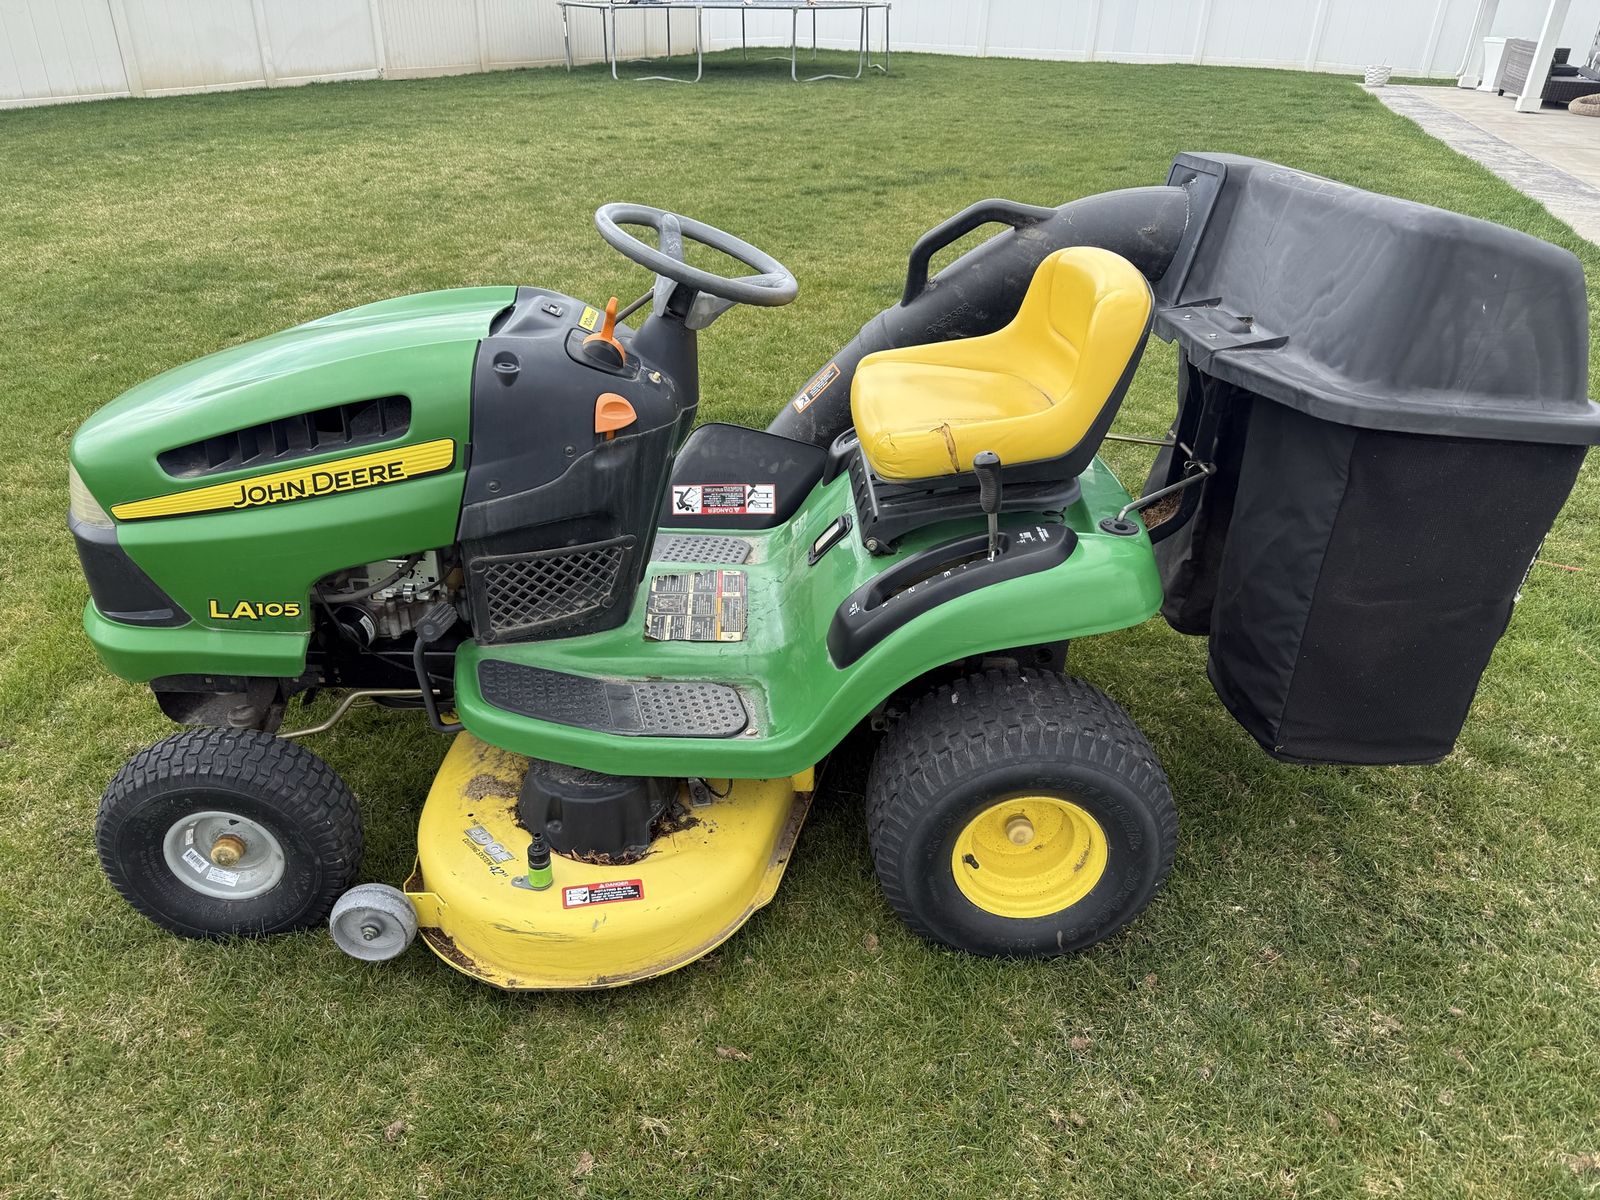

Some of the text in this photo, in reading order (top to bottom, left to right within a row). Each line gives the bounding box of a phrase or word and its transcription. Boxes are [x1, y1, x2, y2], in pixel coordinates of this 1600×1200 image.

[234, 461, 405, 507] JOHN DEERE
[209, 600, 301, 620] LA105
[463, 825, 514, 864] EDGE
